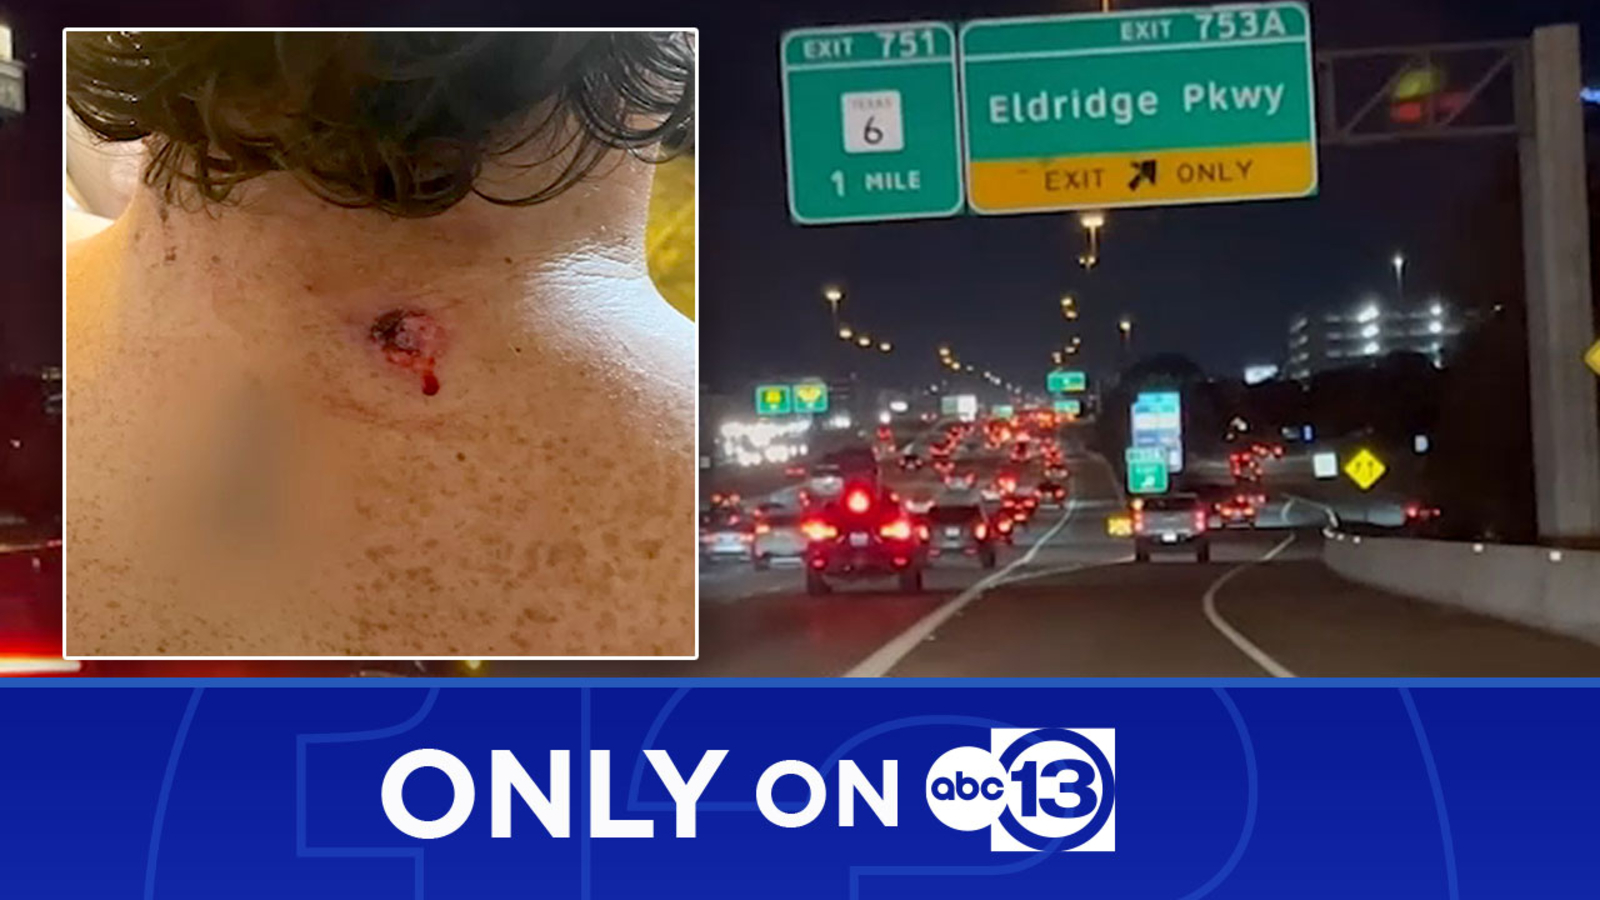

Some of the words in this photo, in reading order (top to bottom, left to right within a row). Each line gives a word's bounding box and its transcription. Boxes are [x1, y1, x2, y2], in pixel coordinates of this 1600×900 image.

[1121, 20, 1172, 42] EXIT
[1195, 10, 1287, 40] 753A
[803, 37, 853, 60] EXIT
[876, 29, 936, 57] 751
[989, 89, 1159, 124] Eldridge
[1183, 82, 1285, 116] Pkwy
[863, 116, 884, 145] 6
[830, 171, 845, 196] 1
[864, 170, 921, 191] MILE
[1044, 168, 1105, 192] EXIT
[1176, 160, 1254, 184] ONLY
